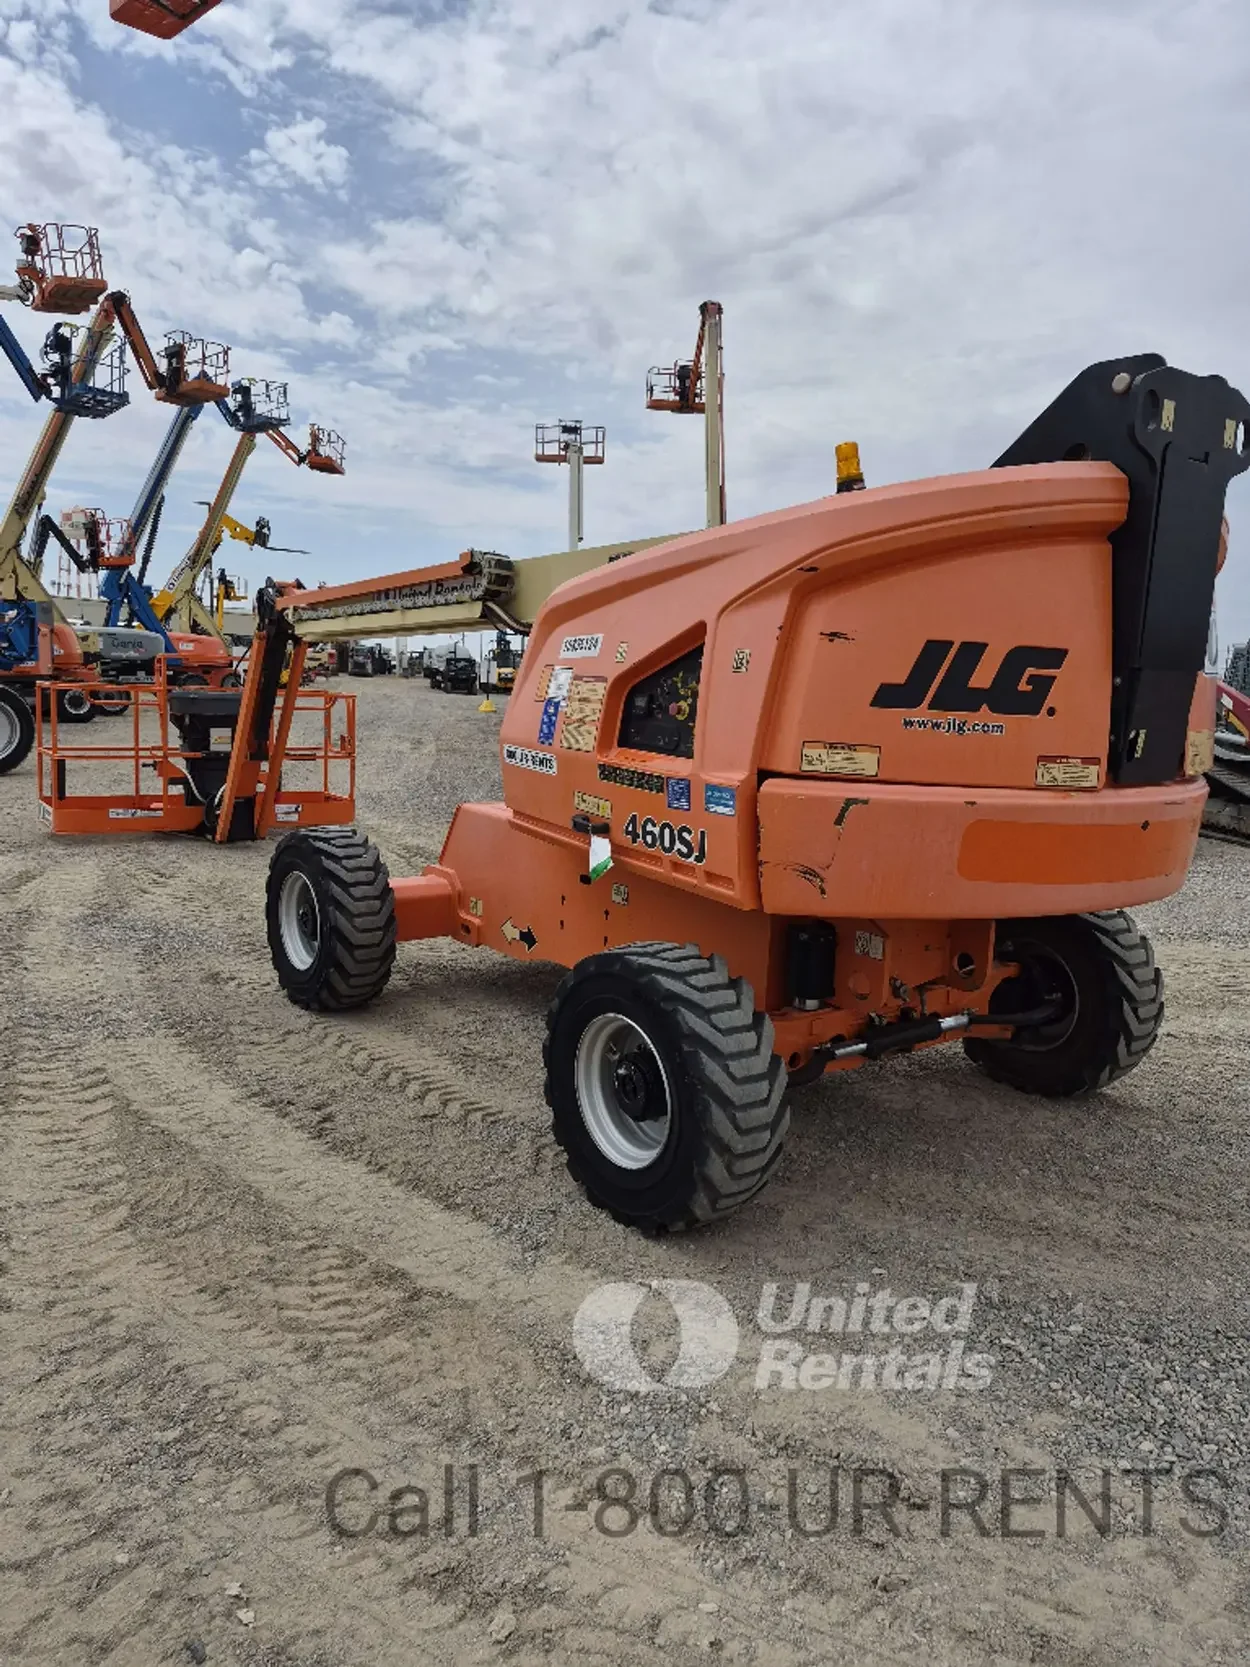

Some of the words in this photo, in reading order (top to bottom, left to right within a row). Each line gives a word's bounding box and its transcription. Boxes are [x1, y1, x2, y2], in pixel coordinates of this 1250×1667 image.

[869, 640, 1069, 716] JLG
[902, 717, 1005, 735] www.jlg.com
[623, 812, 707, 865] 460SJ
